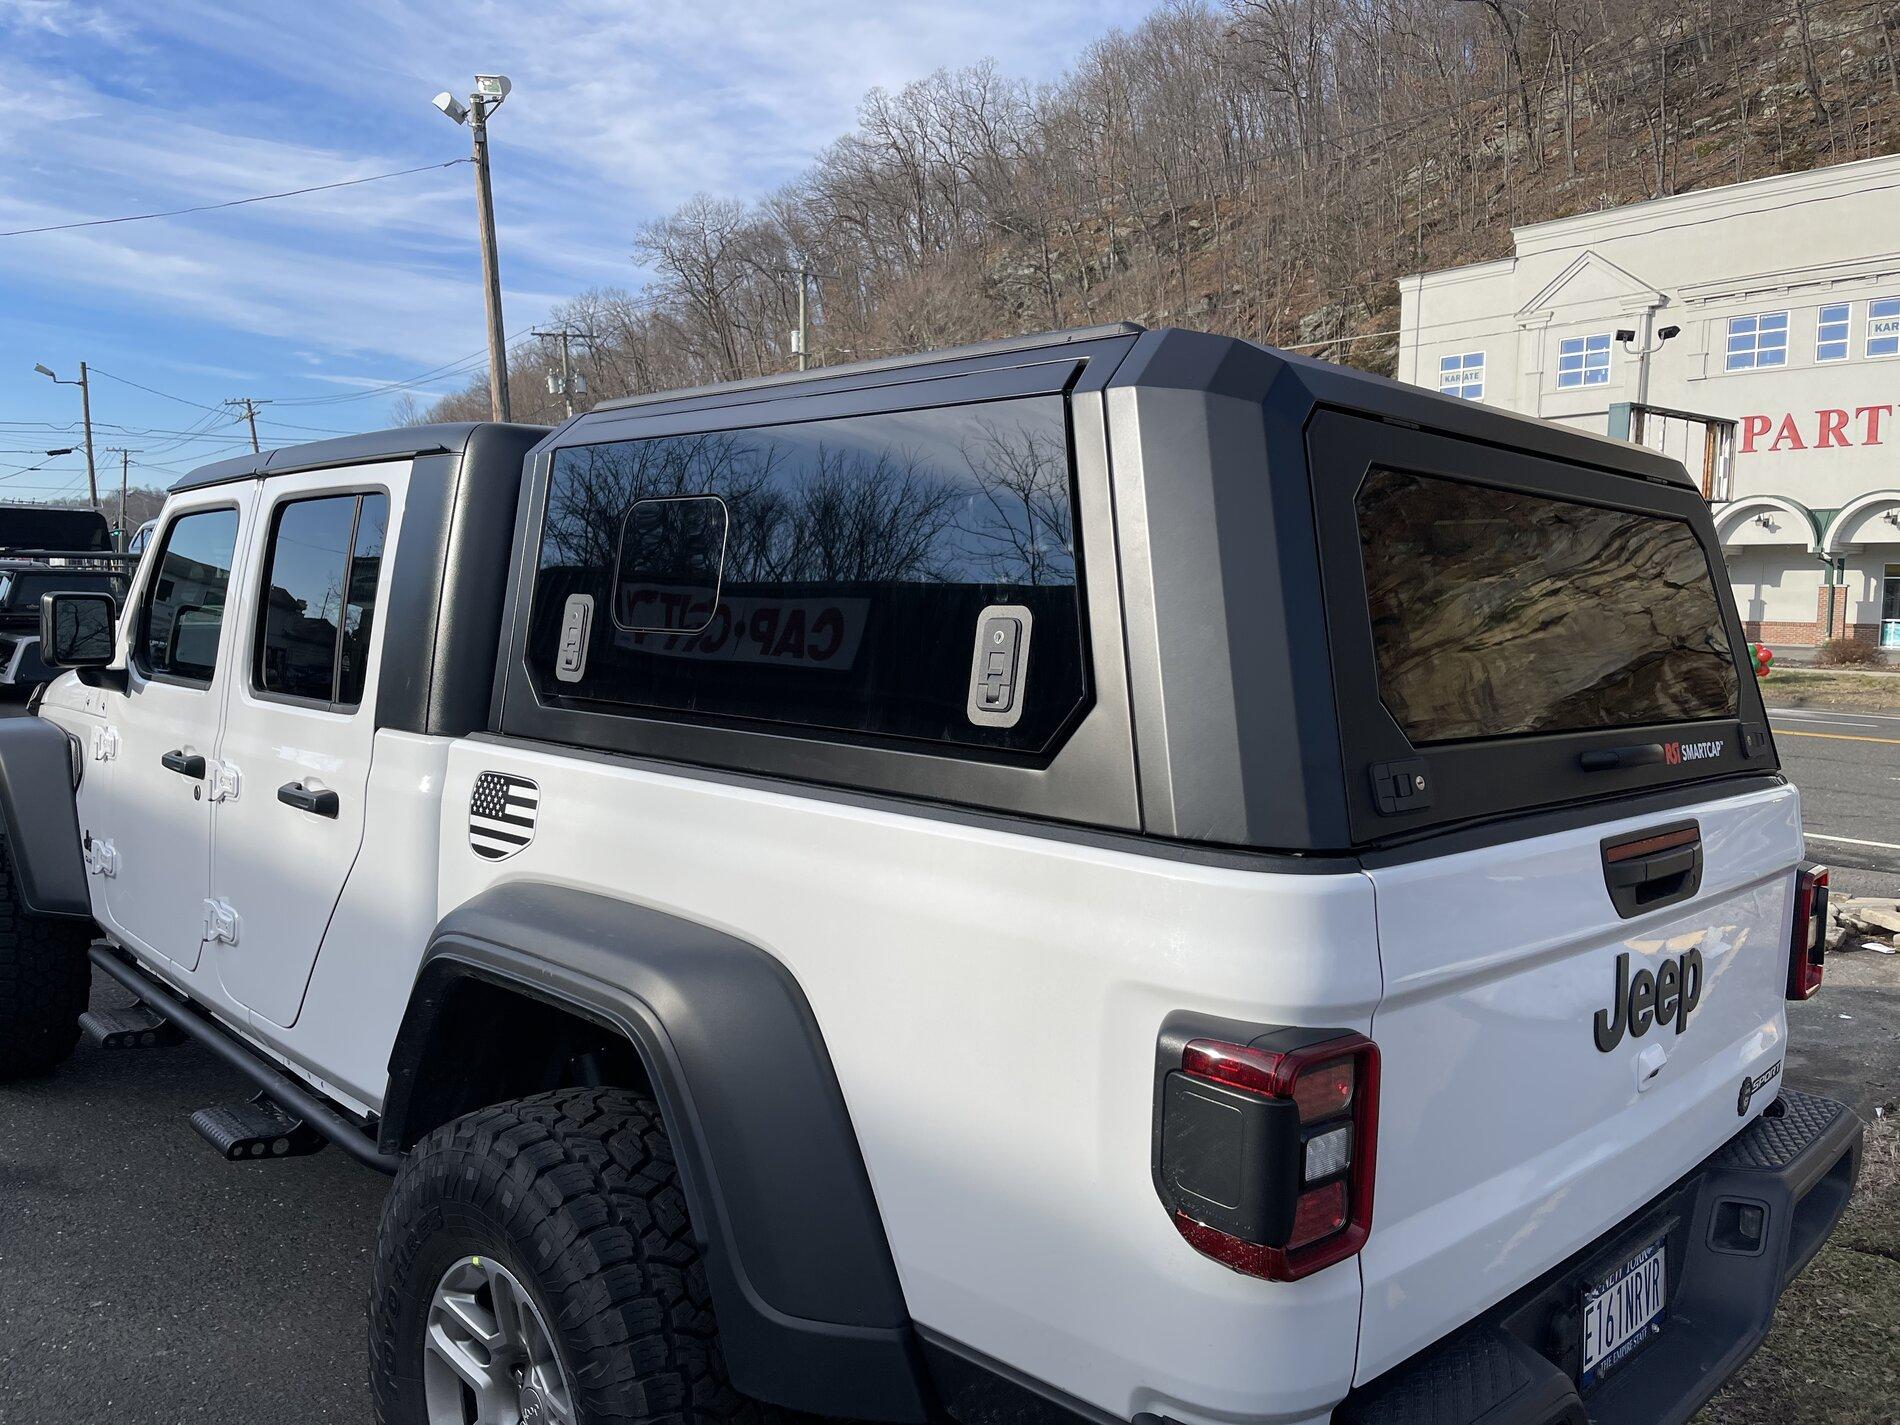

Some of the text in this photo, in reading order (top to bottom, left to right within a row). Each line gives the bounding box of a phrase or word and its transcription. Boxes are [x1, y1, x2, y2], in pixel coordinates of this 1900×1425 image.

[1738, 404, 1900, 454] PART
[1593, 947, 1704, 1053] Jeep
[1751, 1061, 1782, 1094] SPORT
[1584, 1257, 1660, 1367] E161NRVR
